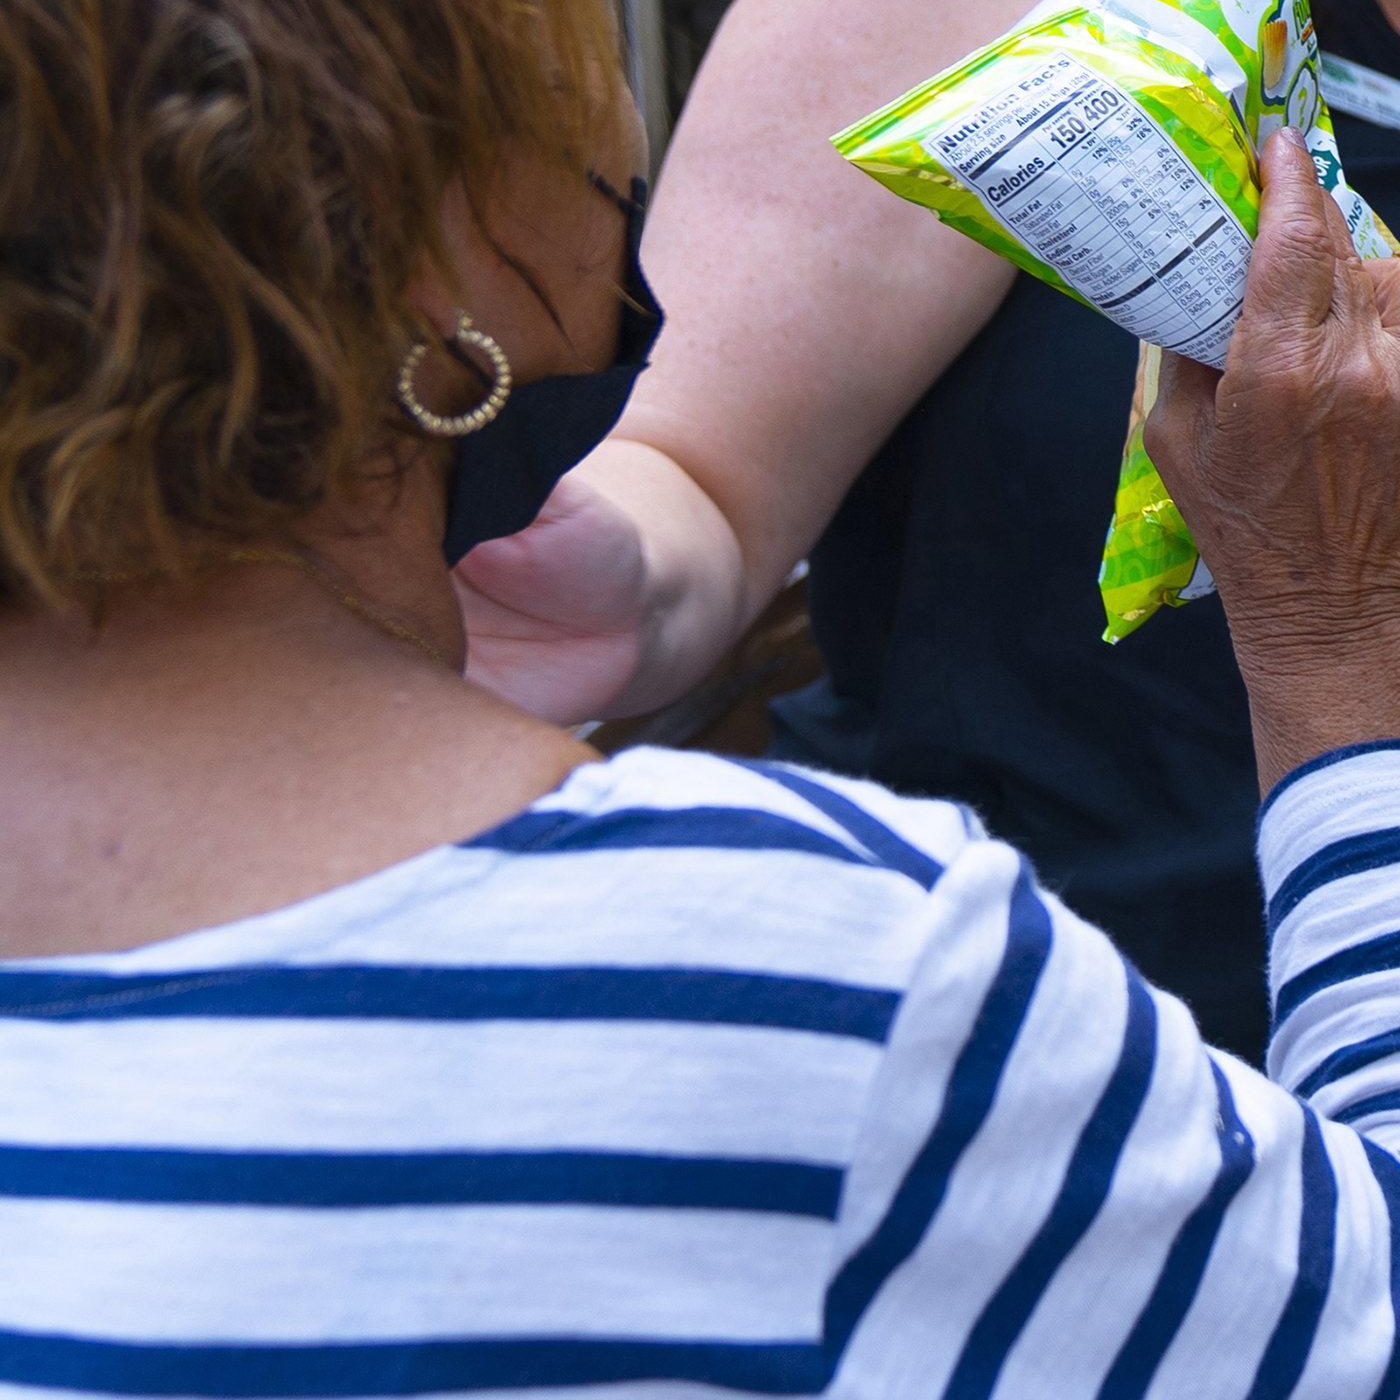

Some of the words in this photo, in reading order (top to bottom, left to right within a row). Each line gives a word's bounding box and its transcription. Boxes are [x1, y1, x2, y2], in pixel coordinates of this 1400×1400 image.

[940, 93, 1021, 153] Nutrition
[1019, 60, 1070, 91] Facts
[949, 144, 971, 164] About
[969, 133, 985, 146] 2.5
[983, 114, 1014, 136] servings
[959, 148, 991, 173] Serving
[990, 134, 1006, 148] size
[1016, 108, 1040, 127] About
[1038, 100, 1050, 109] 15
[1050, 87, 1070, 103] chips
[1052, 110, 1072, 125] serving
[988, 158, 1044, 202] Calories
[1051, 118, 1086, 148] 150
[1084, 91, 1119, 121] 400
[1009, 209, 1030, 224] Total
[1027, 200, 1042, 213] Fat
[1092, 148, 1108, 160] 12%
[1107, 136, 1122, 148] 25g
[1126, 118, 1143, 131] 32%
[1023, 208, 1054, 231] Saturated
[1050, 201, 1064, 212] Fat
[1081, 176, 1098, 189] 1.5g
[1104, 157, 1117, 167] 7%
[1116, 144, 1132, 158] 3.5g
[1032, 227, 1051, 239] Trans
[1047, 218, 1061, 231] Fat
[1089, 189, 1101, 199] 0g
[1037, 224, 1077, 251] Cholesterol
[1098, 196, 1114, 209] 0mg
[1121, 178, 1135, 188] 0%
[1157, 148, 1170, 158] 0%
[1046, 242, 1072, 261] Sodium
[1106, 201, 1130, 220] 200mg
[1130, 188, 1144, 199] 9%
[1162, 158, 1178, 172] 22%
[1072, 248, 1092, 261] Carb.
[1116, 218, 1131, 232] 15g
[1139, 198, 1152, 209] 6%
[1171, 168, 1187, 181] 15%
[1347, 201, 1363, 234] UNS
[1068, 264, 1090, 276] Dietary
[1088, 253, 1104, 266] Fiber
[1124, 230, 1135, 239] 1g
[1148, 209, 1161, 220] 5%
[1180, 179, 1195, 191] 12%
[1092, 264, 1113, 280] Sugars
[1132, 241, 1144, 249] 1g
[1168, 211, 1180, 220] 3g
[1104, 270, 1122, 287] Added
[1120, 258, 1142, 276] Sugars
[1142, 248, 1155, 259] <1g
[1176, 220, 1188, 230] 2g
[1199, 200, 1212, 210] 3%
[1163, 271, 1183, 286] 0mcg
[1188, 256, 1201, 266] 0%
[1199, 241, 1218, 256] 0mcg
[1222, 226, 1234, 236] 0%
[1149, 261, 1161, 270] 2g
[1172, 281, 1191, 296] 10mg
[1197, 266, 1209, 276] 0%
[1208, 250, 1227, 266] 20mg
[1231, 236, 1241, 246] 0%
[1180, 290, 1202, 306] 0.5mg
[1205, 276, 1217, 286] 2%
[1217, 260, 1237, 275] 1.4mg
[1238, 246, 1249, 256] 6%
[1188, 298, 1211, 316] 340mg
[1214, 286, 1226, 296] 6%
[1225, 268, 1245, 286] 900mg
[1224, 297, 1235, 307] 6%
